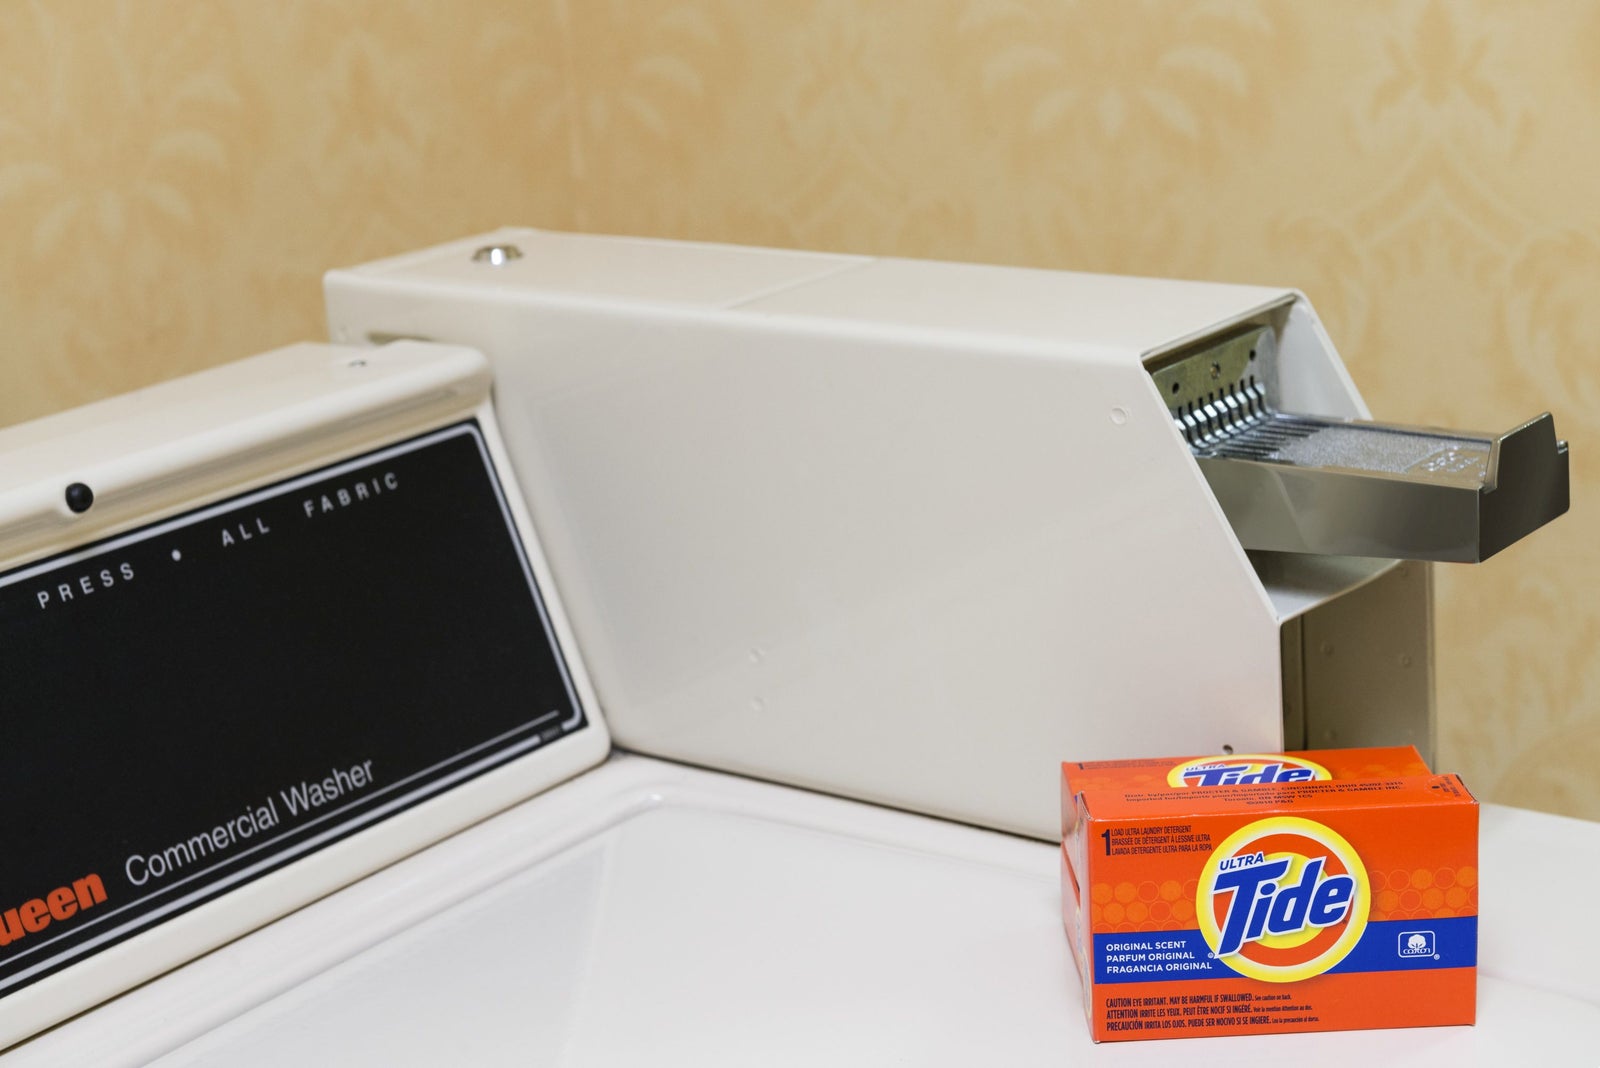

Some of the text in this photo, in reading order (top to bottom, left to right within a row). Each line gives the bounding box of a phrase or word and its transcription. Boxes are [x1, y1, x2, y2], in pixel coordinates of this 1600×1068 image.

[37, 471, 400, 609] PRESS ALL FABRIC
[124, 797, 281, 887] Commercial
[279, 759, 376, 816] Washer
[1111, 825, 1192, 836] LOAD ULTRA LAUNDRY DETERGENT
[1101, 829, 1111, 856] 1
[1112, 837, 1133, 846] BRASSÉE
[1142, 836, 1170, 845] DÉTERGENT
[1176, 835, 1194, 843] LESSIVE
[1196, 834, 1211, 842] ULTRA
[1112, 847, 1130, 856] LAVADA
[1131, 846, 1162, 855] DETERGENTE
[1163, 845, 1177, 853] ULTRA
[1179, 844, 1191, 852] PARA
[1219, 852, 1264, 871] ULTRA
[1213, 859, 1355, 955] Tide
[1106, 940, 1186, 951] ORIGINAL SCENT
[1106, 952, 1195, 963] PARFUM ORIGINAL
[1107, 962, 1212, 974] FRAGANCIA ORIGINAL
[1106, 998, 1132, 1008] CAUTION
[1133, 998, 1142, 1007] EYE
[1143, 997, 1168, 1006] IRRITANT.
[1170, 996, 1180, 1005] MAY
[1182, 996, 1188, 1004] BE
[1189, 995, 1213, 1004] HARMFUL
[1214, 995, 1219, 1003] IF
[1220, 993, 1254, 1002] SWALLOWED.
[1107, 1009, 1138, 1019] ATTENTION
[1140, 1008, 1156, 1017] IRRITE
[1157, 1008, 1166, 1017] LES
[1167, 1008, 1181, 1016] YEUX.
[1183, 1007, 1196, 1016] PEUT
[1197, 1005, 1209, 1015] ÊTRE
[1211, 1006, 1225, 1014] NOCIF
[1107, 1019, 1143, 1031] PRECAUCIÓN
[1144, 1020, 1160, 1029] IRRITA
[1162, 1020, 1171, 1028] LOS
[1188, 1019, 1204, 1027] PUEDE
[1206, 1018, 1214, 1027] SER
[1216, 1017, 1234, 1026] NOCIVO
[1237, 1017, 1241, 1025] SI
[1243, 1017, 1248, 1025] SE
